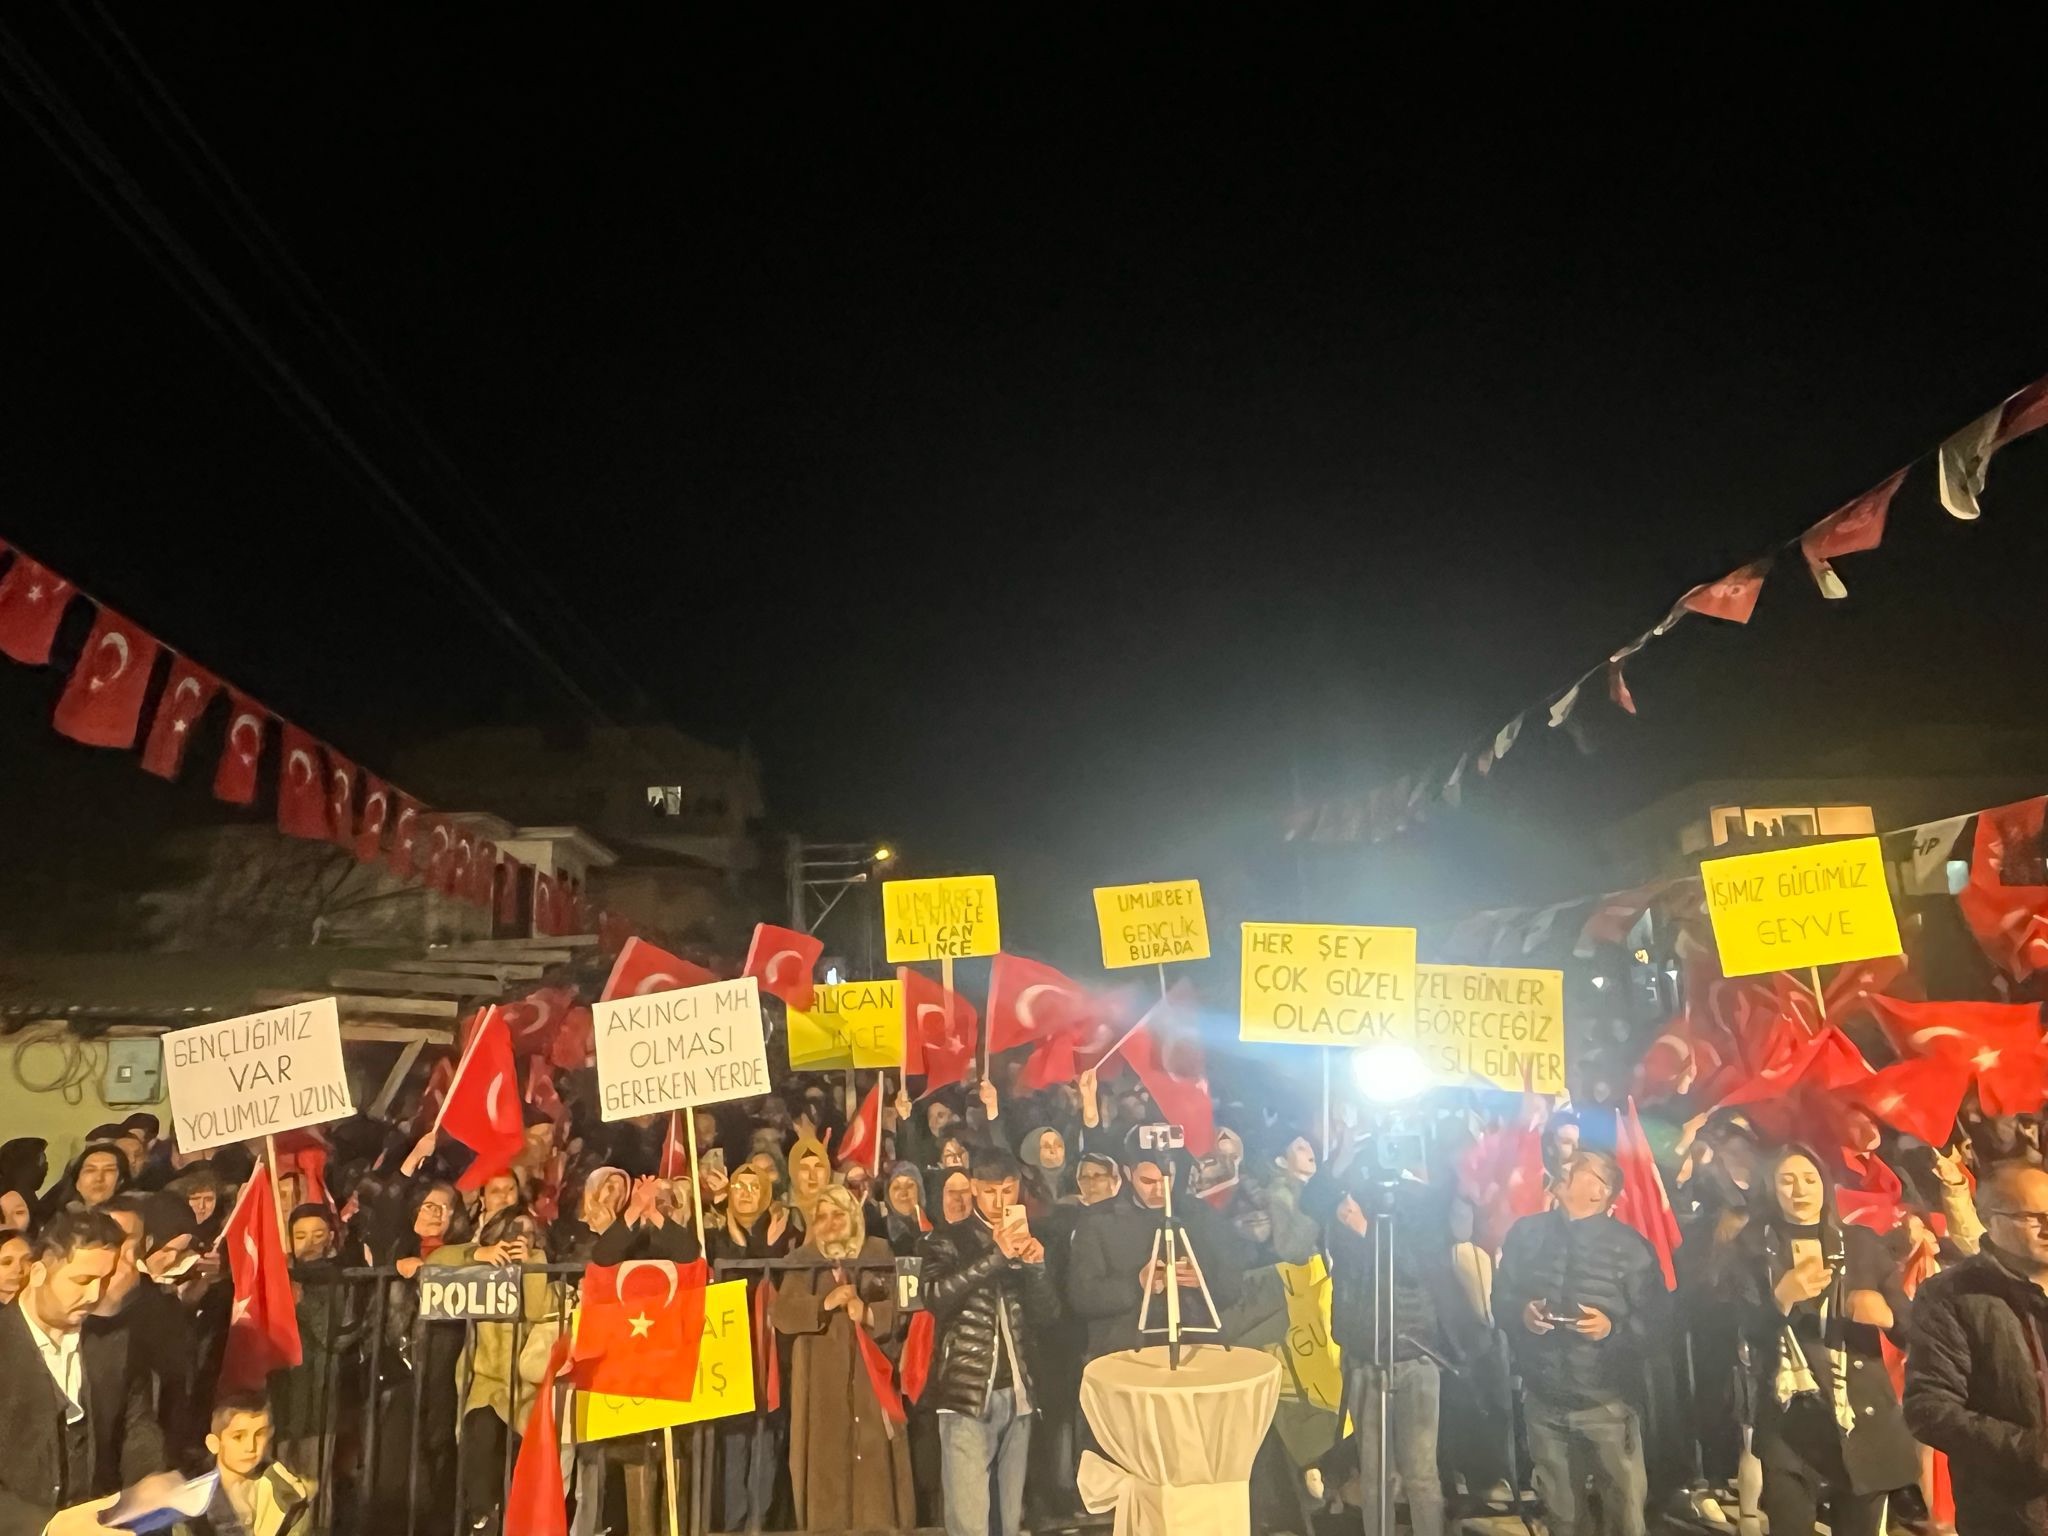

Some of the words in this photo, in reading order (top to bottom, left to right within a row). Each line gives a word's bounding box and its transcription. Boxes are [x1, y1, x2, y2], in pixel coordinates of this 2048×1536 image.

[1117, 888, 1195, 913] UMURBEY
[1122, 916, 1199, 943] GENÇLİK
[1757, 910, 1854, 945] GEYVE
[1129, 940, 1194, 961] BURADA
[1252, 932, 1294, 954] HER
[1318, 934, 1373, 961] ŞEY
[1254, 964, 1308, 993] ÇOK
[1326, 967, 1405, 1001] GÜZEL
[1463, 972, 1545, 1006] GÜNLER
[607, 996, 699, 1036] AKINCI
[1273, 1003, 1398, 1040] OLACAK
[630, 1026, 733, 1068] OLMASI
[229, 1054, 292, 1092] VAR
[605, 1070, 698, 1112] GEREKEN
[705, 1058, 764, 1092] YERDE
[182, 1095, 281, 1142] YOLUMUZ
[290, 1081, 347, 1119] UZUN
